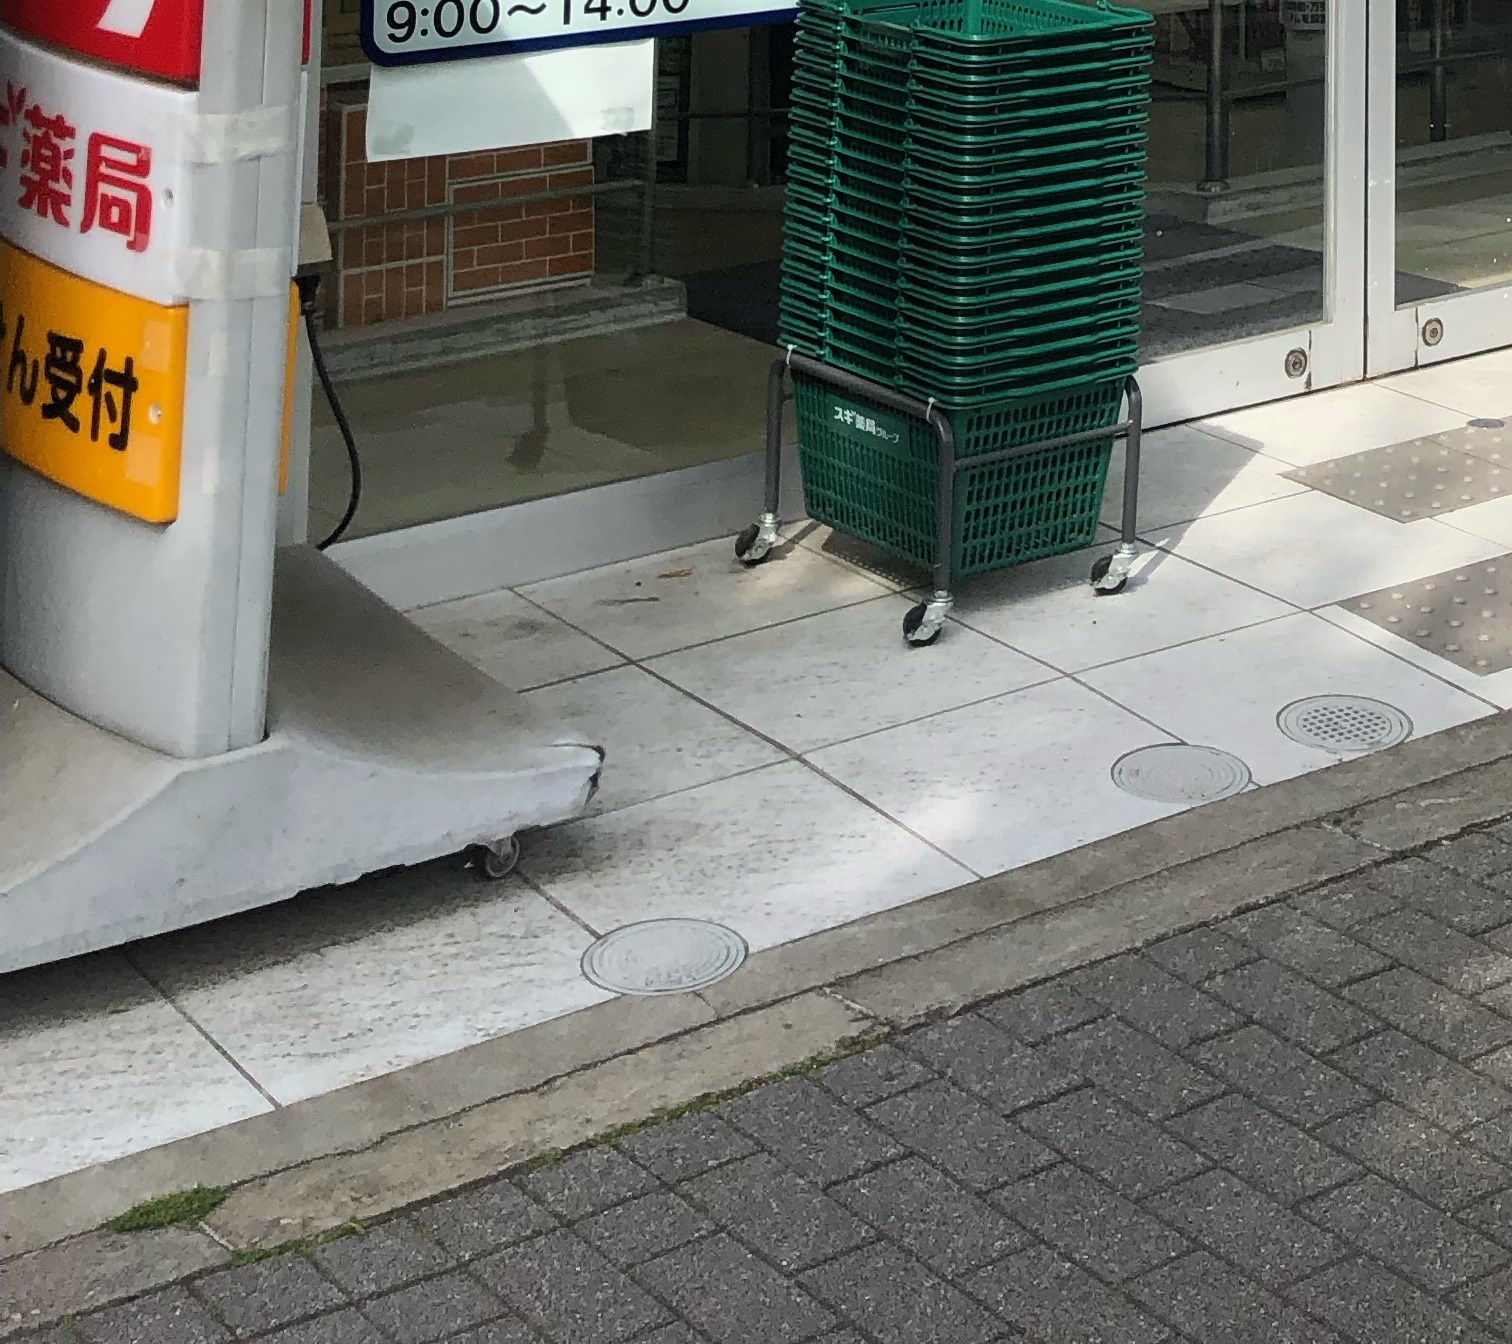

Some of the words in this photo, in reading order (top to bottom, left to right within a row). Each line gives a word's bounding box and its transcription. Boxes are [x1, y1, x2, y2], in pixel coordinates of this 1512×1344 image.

[0, 78, 153, 254] 薬局
[0, 308, 139, 452] ん受付
